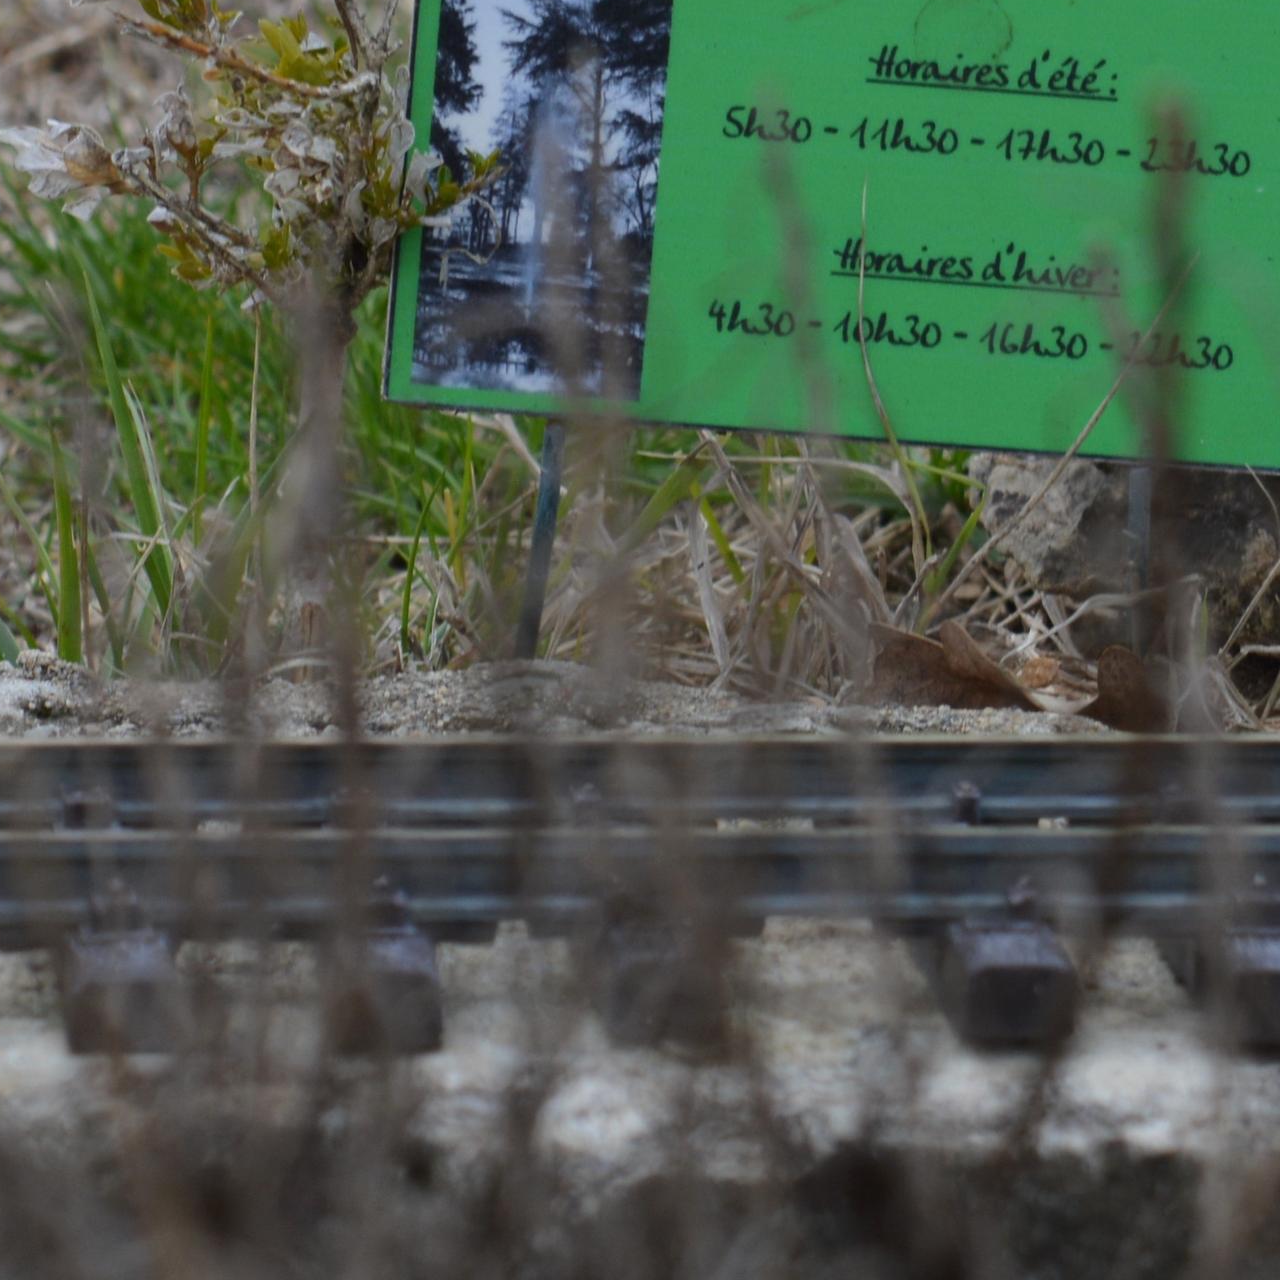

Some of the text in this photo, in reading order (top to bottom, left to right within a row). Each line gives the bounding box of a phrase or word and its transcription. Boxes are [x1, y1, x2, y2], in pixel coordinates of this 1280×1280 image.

[868, 45, 1009, 87] Horaires
[722, 105, 812, 143] 5h30
[849, 116, 959, 155] 11h30
[996, 128, 1105, 166] 17h30
[832, 237, 974, 280] Horaires
[708, 299, 797, 337] 4h30
[832, 311, 942, 349] 10h30
[978, 322, 1088, 360] 16h30
